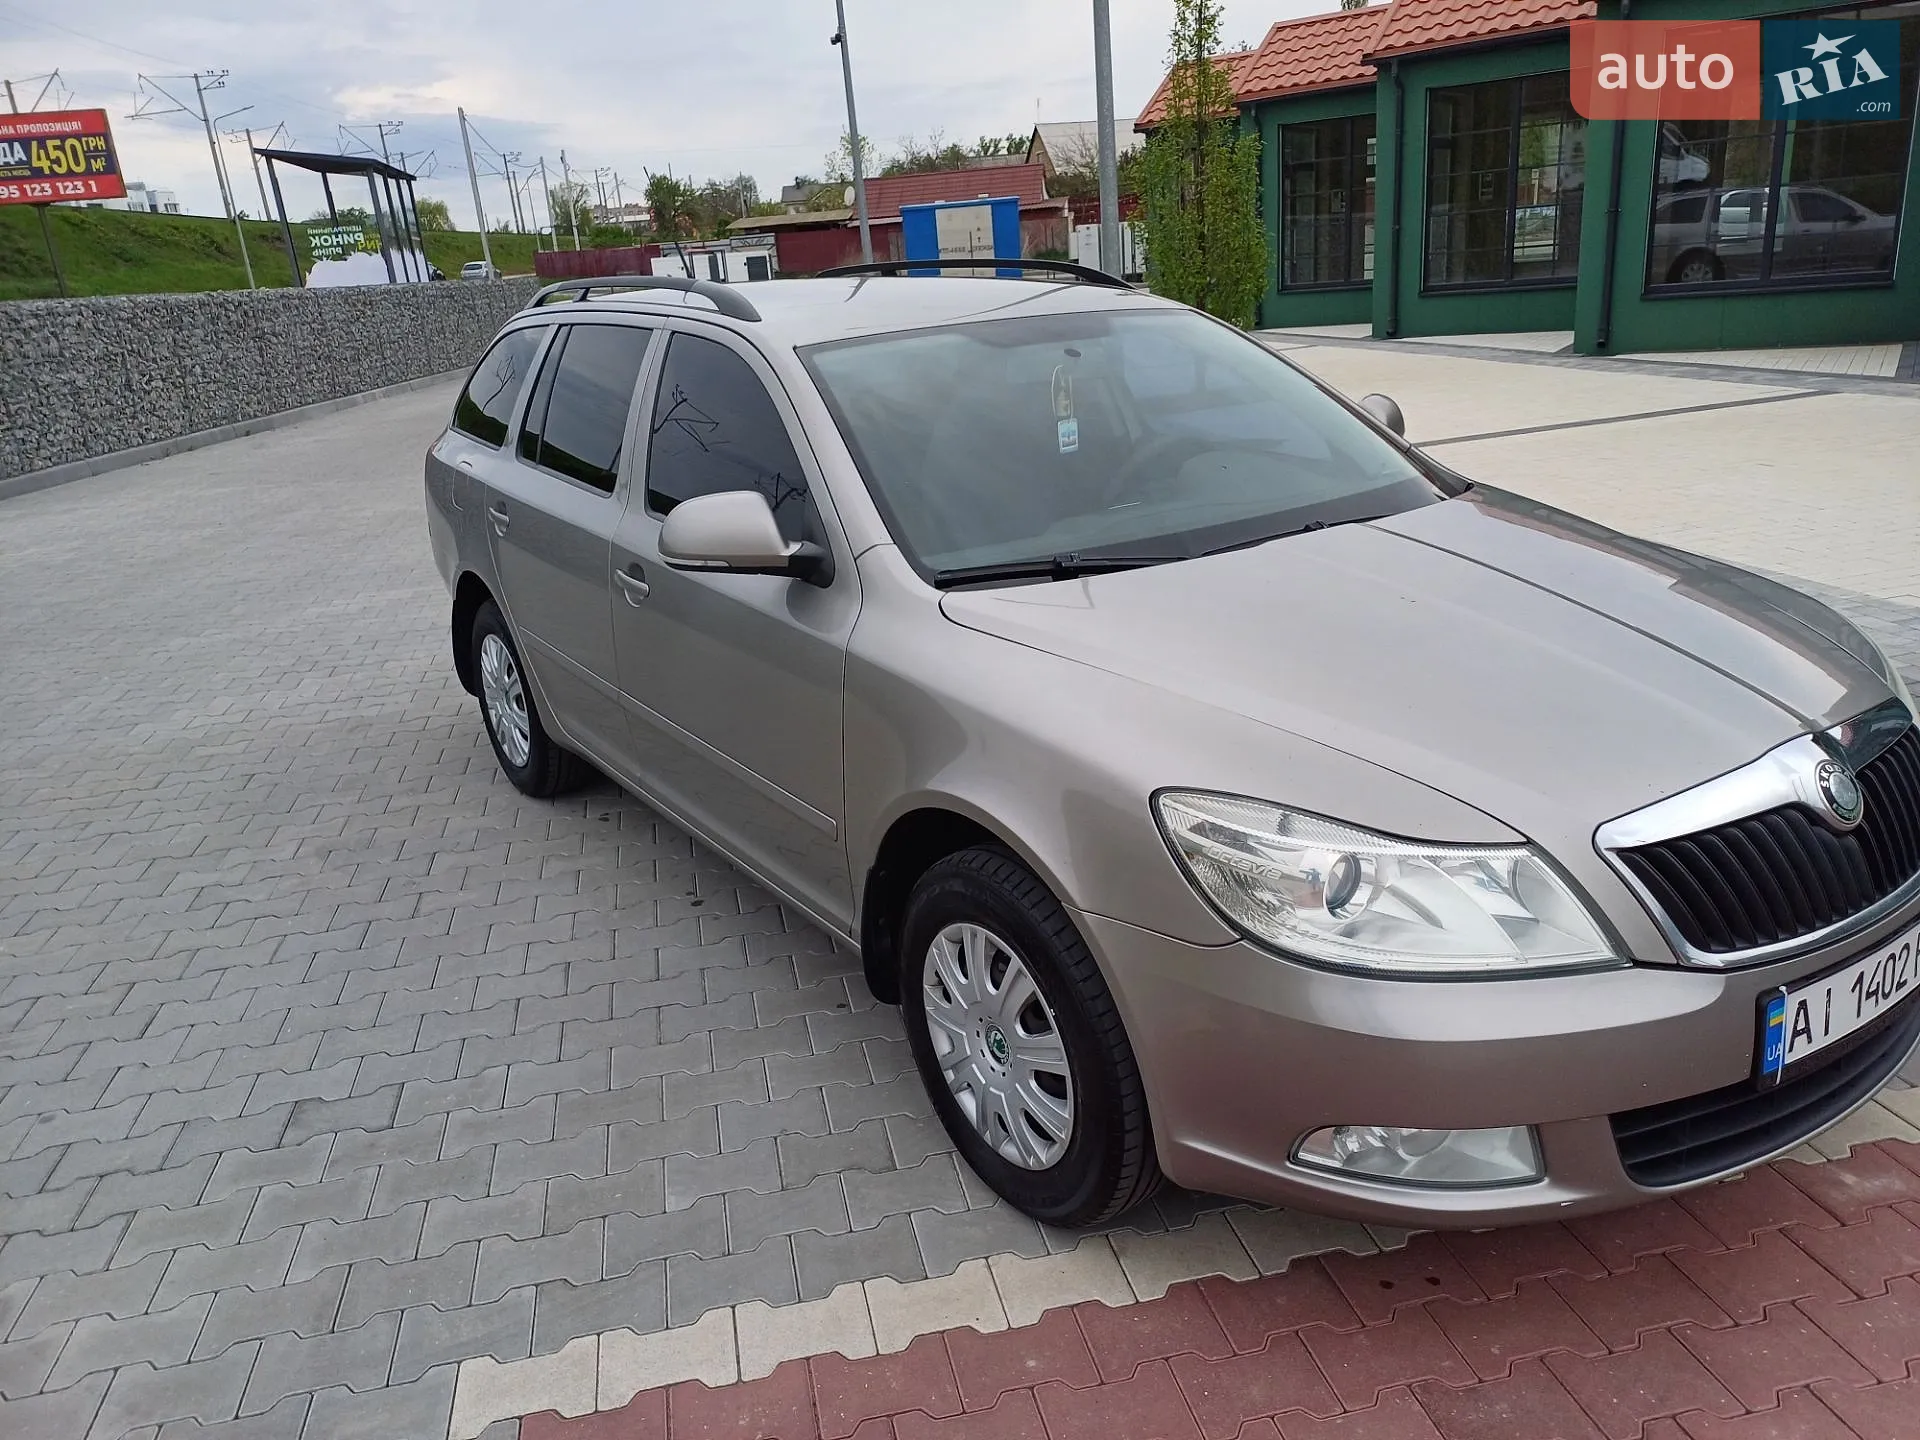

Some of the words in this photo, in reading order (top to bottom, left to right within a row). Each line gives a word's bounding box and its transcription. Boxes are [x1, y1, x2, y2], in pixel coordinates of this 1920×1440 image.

[0, 126, 14, 135] НА
[16, 120, 82, 134] ПРОПОЗИЦІЯ!
[81, 136, 106, 152] ГРН
[31, 138, 86, 175] 450
[0, 185, 20, 199] 95
[23, 183, 52, 197] 123
[55, 180, 85, 195] 123
[87, 180, 97, 193] 1
[1851, 943, 1910, 1019] 1402
